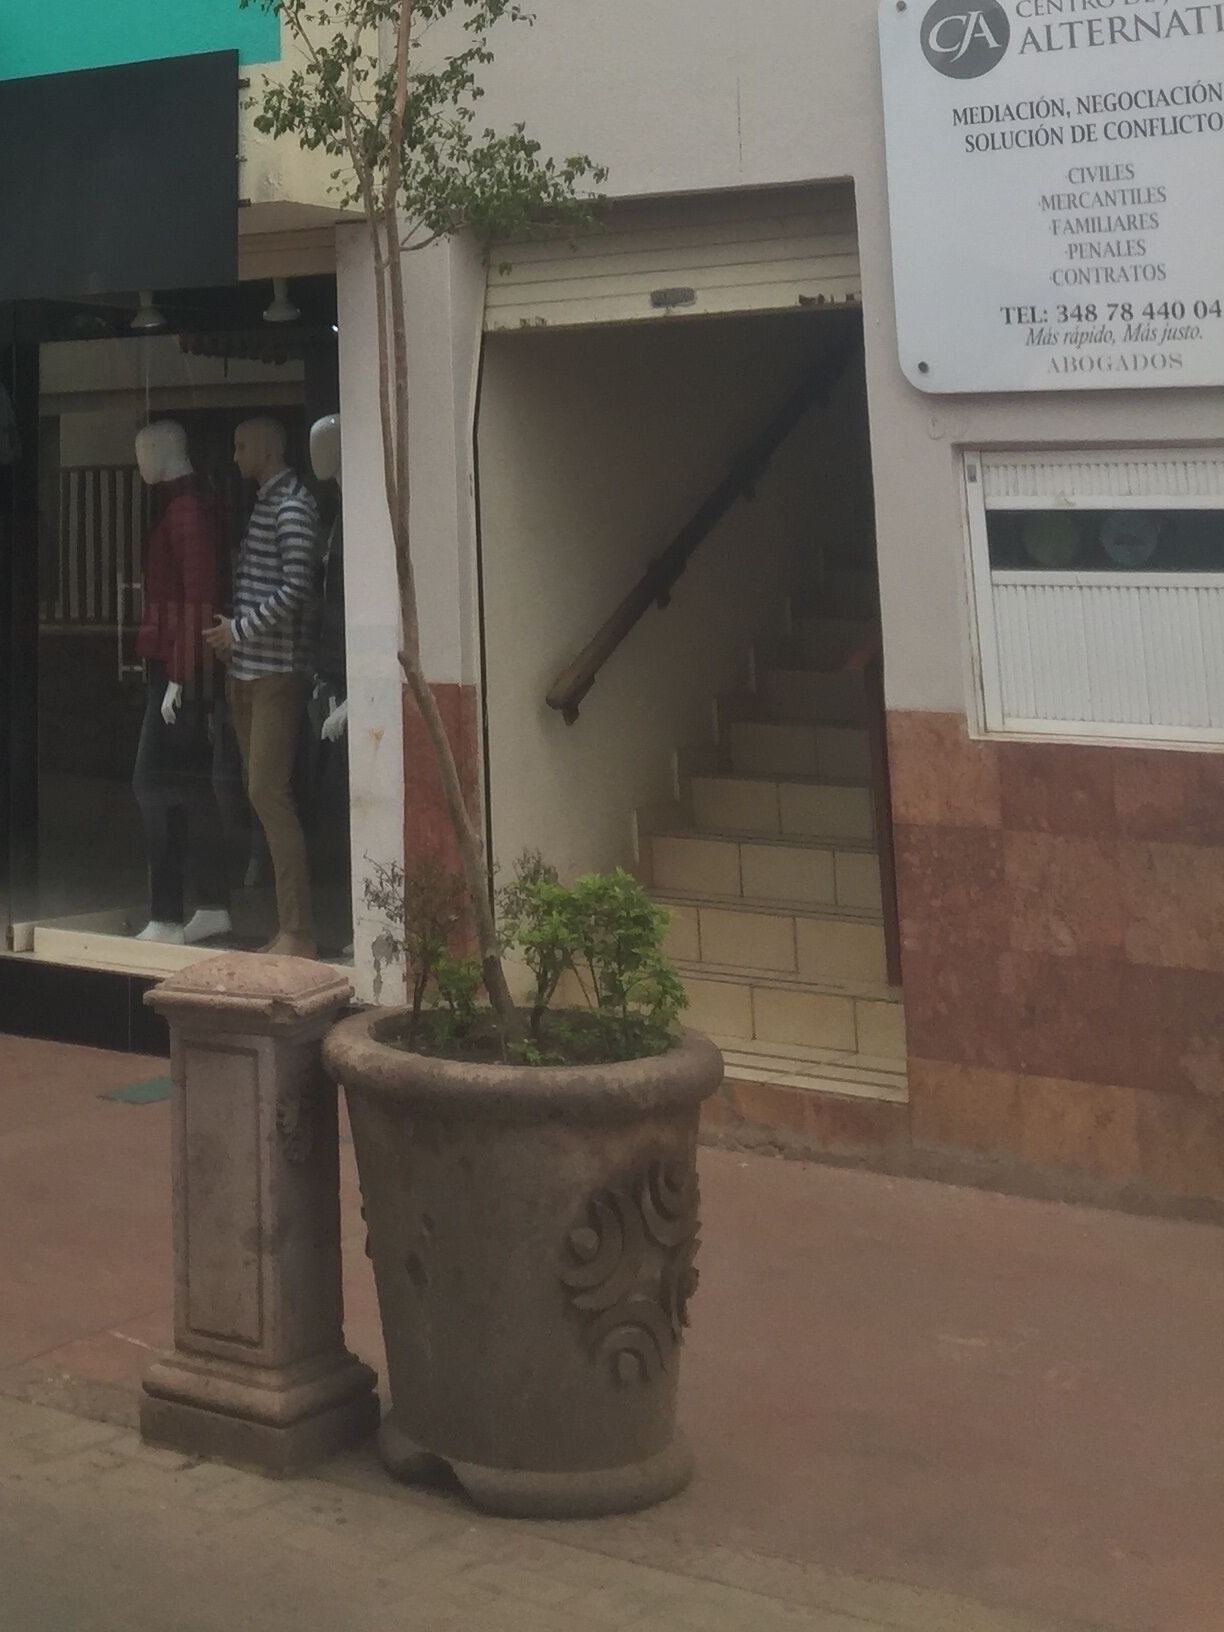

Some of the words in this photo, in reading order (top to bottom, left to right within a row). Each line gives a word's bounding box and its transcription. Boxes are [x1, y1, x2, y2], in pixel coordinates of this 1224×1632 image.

[1017, 4, 1224, 55] ALTERNATI
[952, 96, 1071, 126] MEDIACIÓN,
[1076, 80, 1223, 115] NEGOCIACIÓN
[965, 125, 1064, 153] SOLUCIÓN
[1071, 124, 1098, 144] DE
[1103, 112, 1223, 141] CONFLICTO
[1067, 163, 1135, 185] CIVILES
[1040, 186, 1167, 211] MERCANTILES
[1051, 212, 1160, 236] FAMILIARES
[1067, 239, 1147, 260] PENALES
[1052, 263, 1167, 286] CONTRATOS
[1000, 305, 1048, 325] TEL:
[1056, 303, 1098, 323] 348
[1107, 302, 1134, 322] 78
[1142, 300, 1185, 320] 440
[1194, 299, 1223, 319] 04
[1026, 327, 1058, 347] Más
[1063, 325, 1117, 349] rápido,
[1123, 323, 1157, 343] Más
[1158, 323, 1204, 346] justo.
[1047, 353, 1183, 374] ABOGADOS
